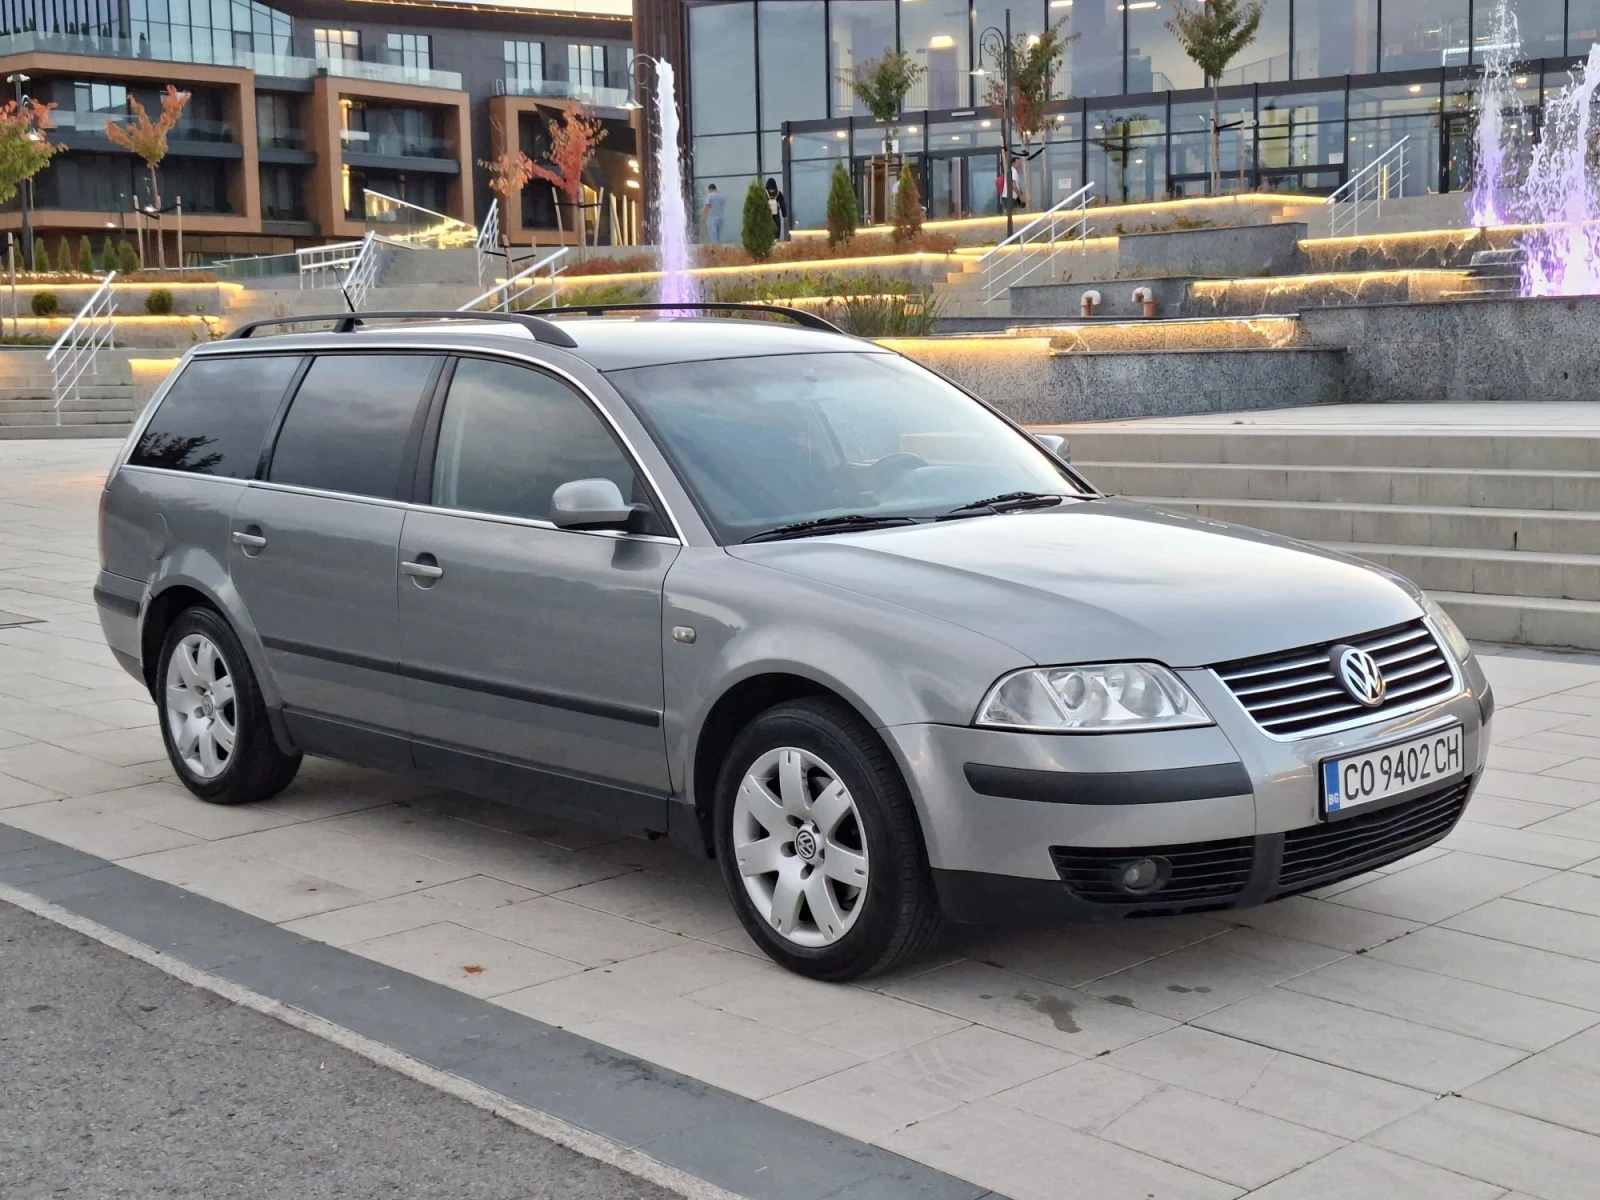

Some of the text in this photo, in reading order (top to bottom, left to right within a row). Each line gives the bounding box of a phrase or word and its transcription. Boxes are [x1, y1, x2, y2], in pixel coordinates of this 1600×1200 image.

[1341, 649, 1382, 704] VW
[1344, 733, 1459, 800] CO 9402 CH
[1328, 792, 1339, 805] BG
